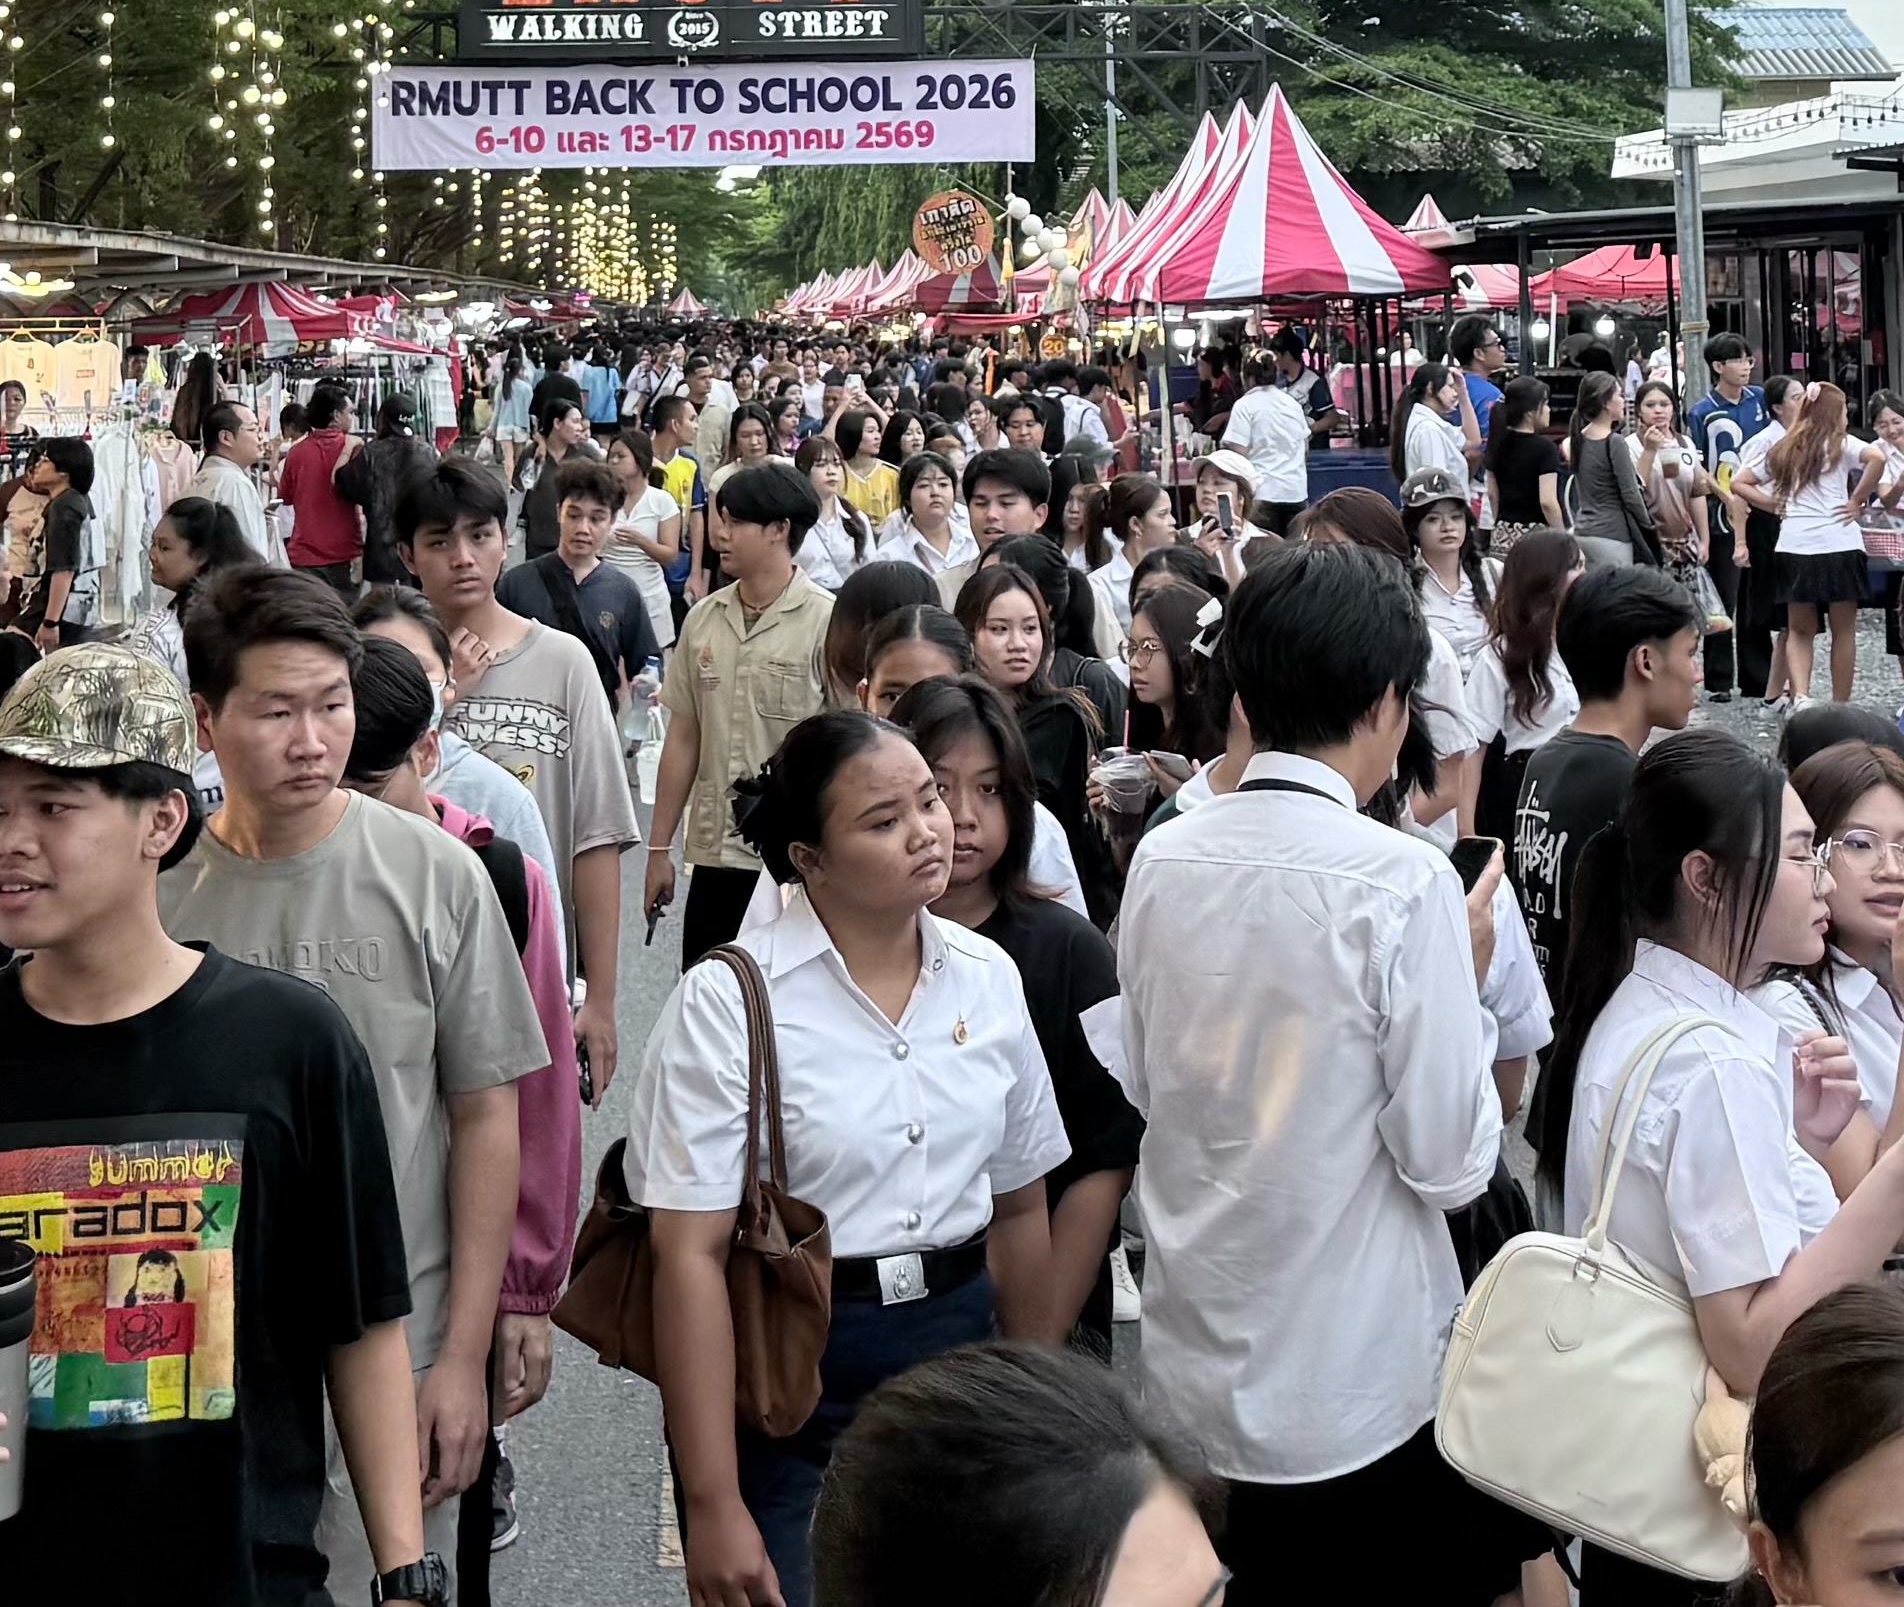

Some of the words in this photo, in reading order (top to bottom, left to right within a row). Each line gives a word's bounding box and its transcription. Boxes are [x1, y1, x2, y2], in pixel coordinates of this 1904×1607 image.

[487, 12, 643, 41] WALKING
[758, 10, 889, 37] STREET
[678, 23, 712, 36] 2015
[391, 79, 532, 117] RMUTT
[546, 78, 656, 115] BACK
[670, 77, 723, 113] TO
[738, 75, 902, 112] SCHOOL
[915, 73, 1016, 110] 2026
[475, 125, 546, 154] 6-10
[557, 125, 610, 153] และ
[619, 124, 696, 152] 13-17
[707, 124, 846, 159] กรกฎาคม
[855, 121, 935, 149] 2569
[939, 244, 983, 272] 100
[1044, 339, 1064, 354] 20
[448, 701, 570, 735] FUNNY
[88, 1140, 233, 1187] summer
